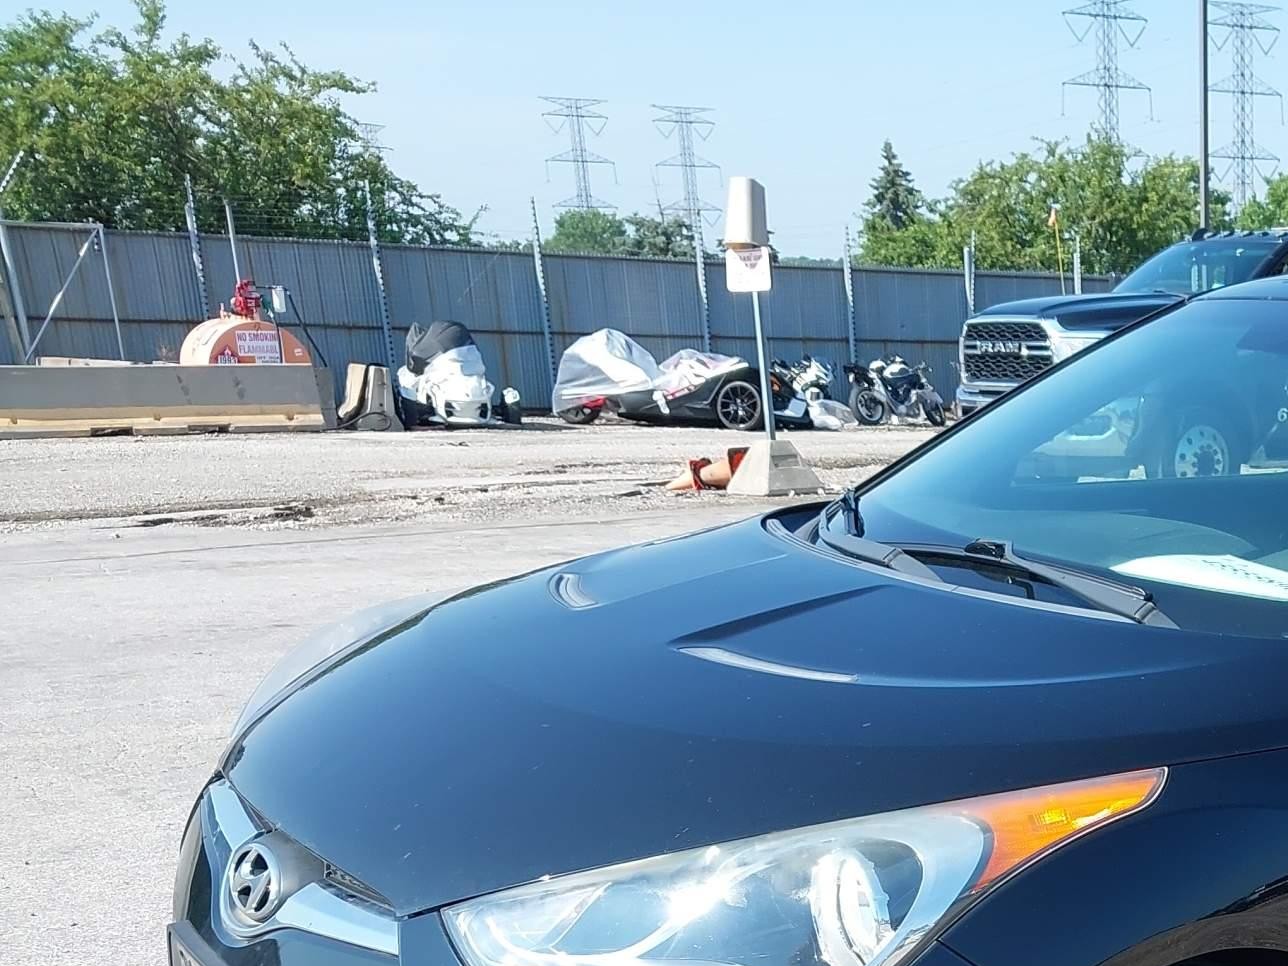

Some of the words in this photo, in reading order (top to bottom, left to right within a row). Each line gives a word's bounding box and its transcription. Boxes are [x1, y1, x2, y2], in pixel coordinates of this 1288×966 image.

[237, 332, 247, 342] NO
[239, 344, 279, 354] FLAMMABL
[980, 341, 1020, 353] RAM
